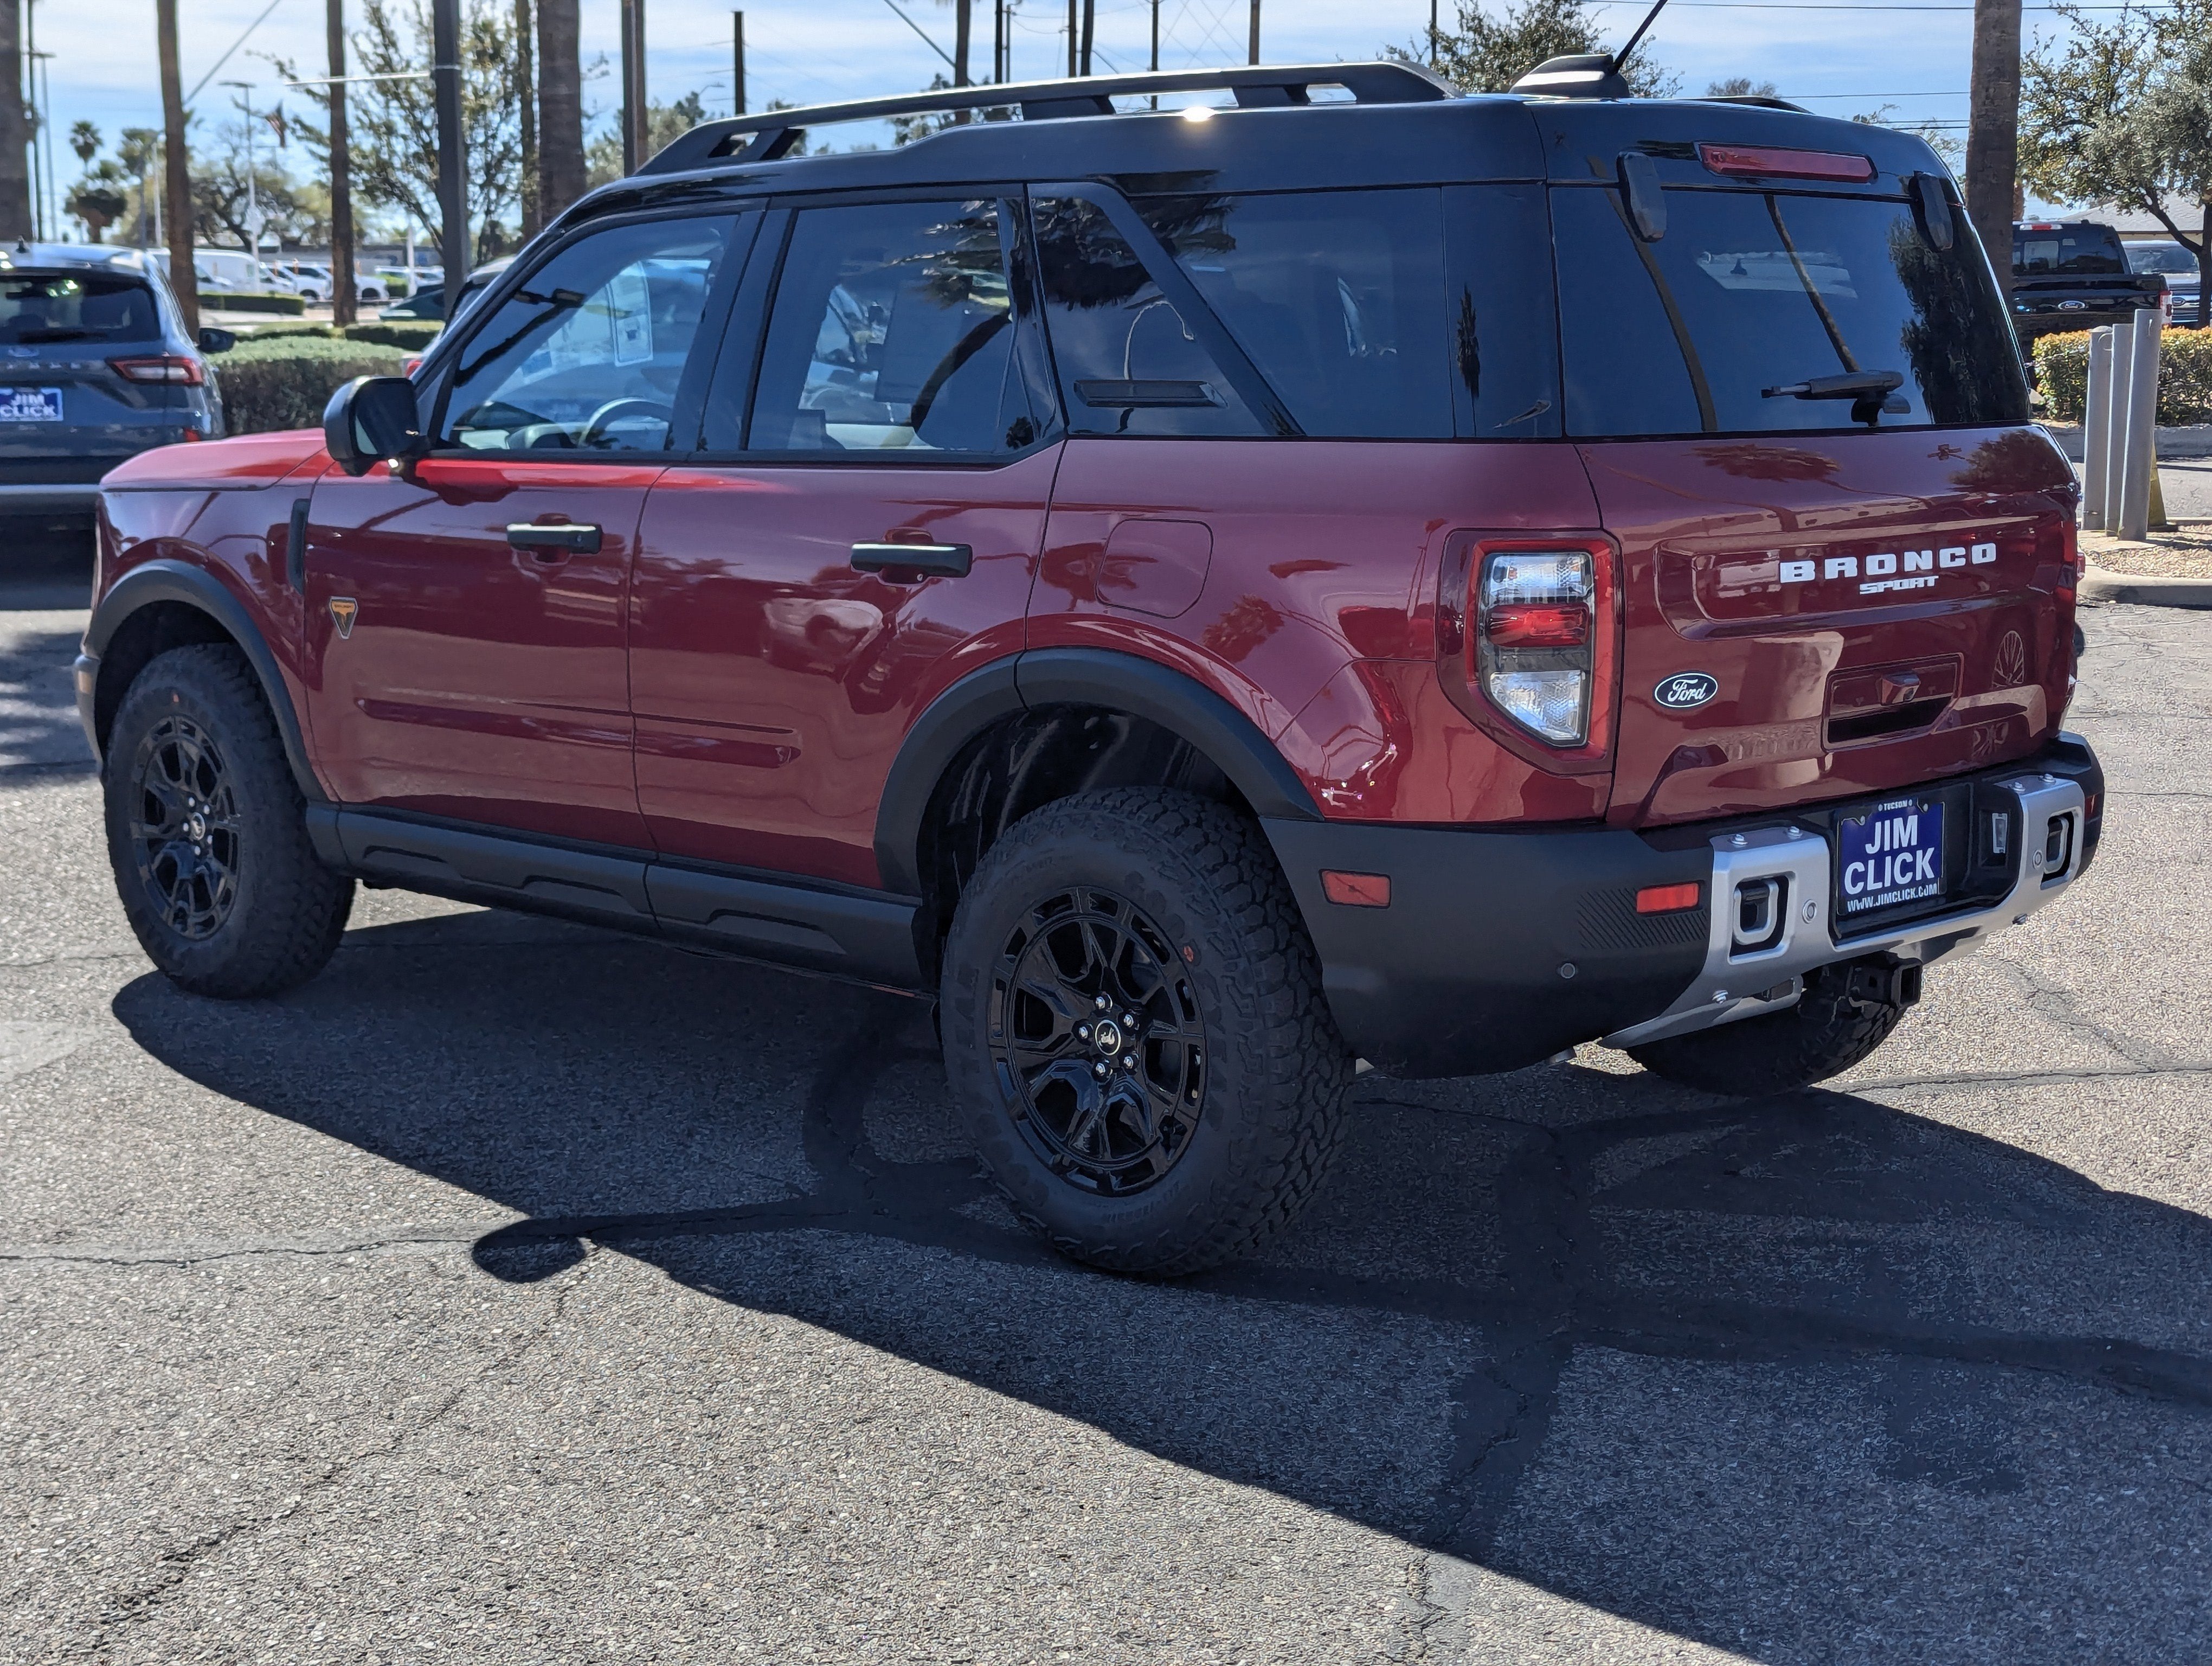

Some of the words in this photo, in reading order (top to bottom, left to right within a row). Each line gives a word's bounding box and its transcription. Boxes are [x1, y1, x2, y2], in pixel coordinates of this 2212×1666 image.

[0, 405, 56, 417] CLICK
[11, 393, 44, 406] JIM
[1780, 543, 1996, 583] BRONCO
[1860, 575, 1939, 594] SPORT
[1668, 678, 1707, 702] Ford
[1865, 815, 1918, 854] JIM
[1844, 847, 1935, 895] CLICK
[1847, 883, 1937, 912] WWW.JIMCLICK.COM
